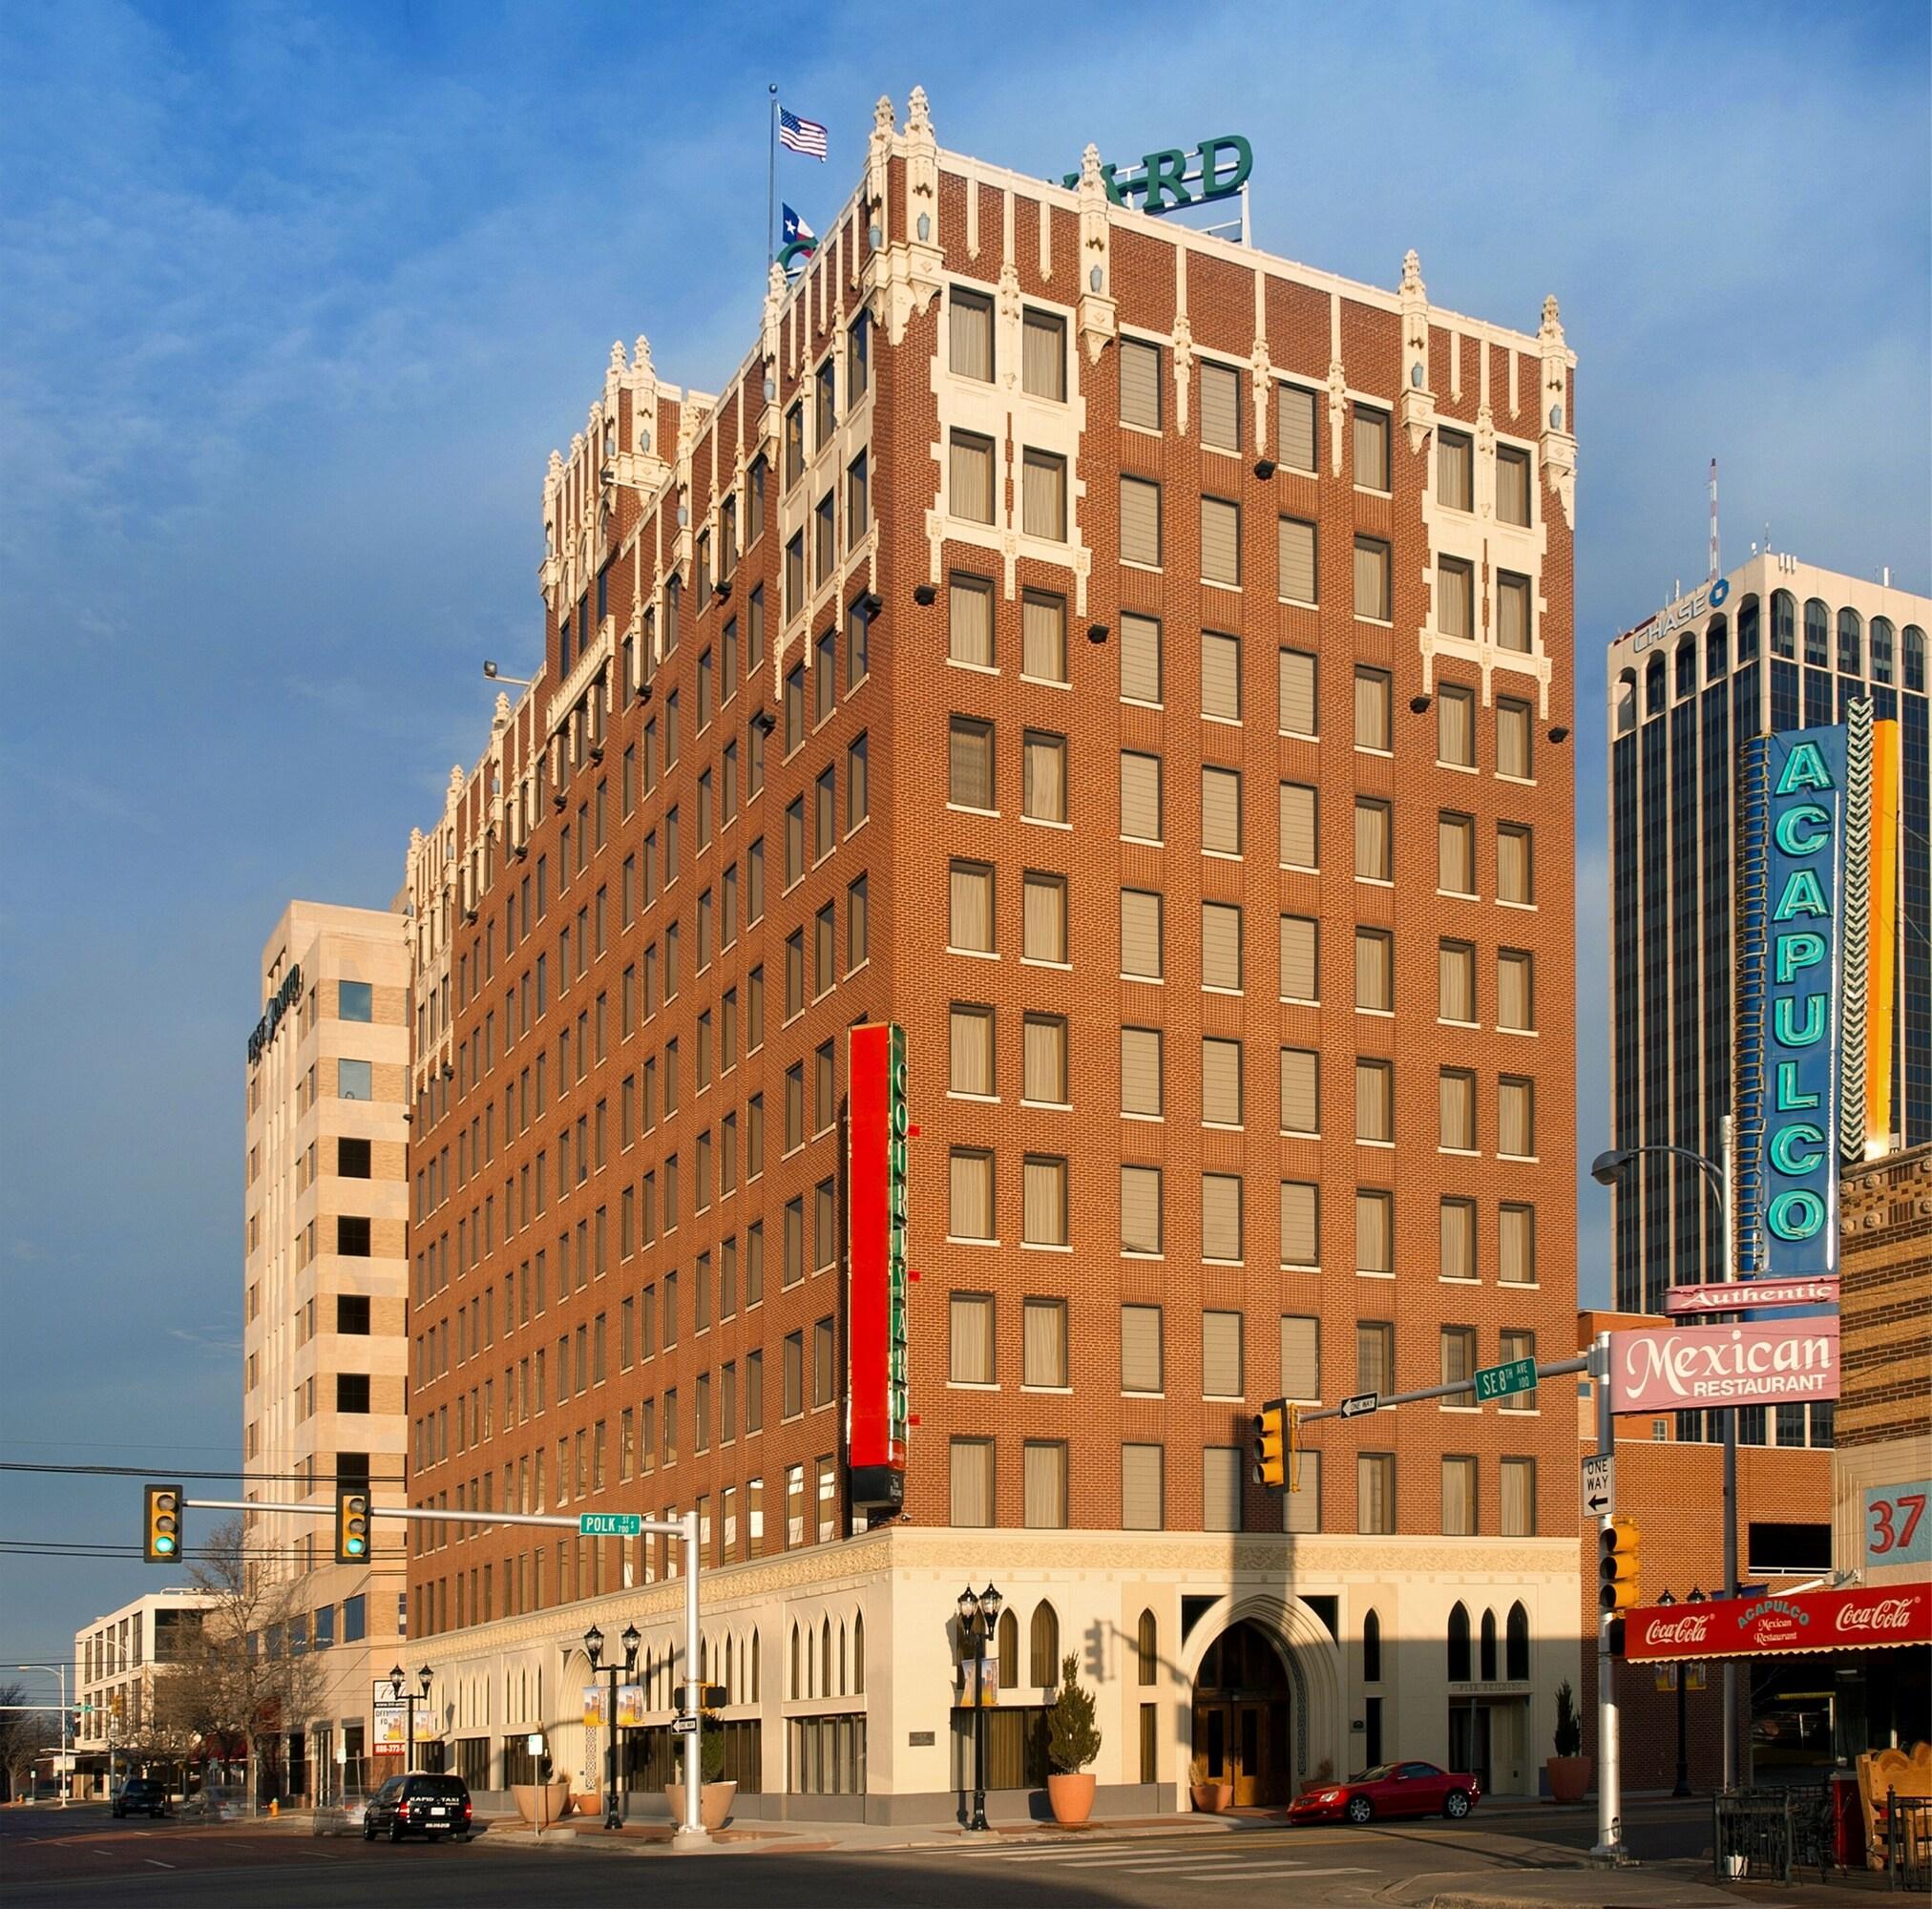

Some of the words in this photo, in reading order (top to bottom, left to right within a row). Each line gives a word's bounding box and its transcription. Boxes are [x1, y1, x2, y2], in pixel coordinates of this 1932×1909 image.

[1633, 593, 1707, 653] CHASE
[1768, 740, 1836, 1241] ACAPULCO
[1681, 1283, 1833, 1307] Authentic
[1626, 1330, 1833, 1398] Mexican
[1482, 1373, 1498, 1395] SE
[1516, 1362, 1528, 1375] AVE
[1693, 1374, 1827, 1397] RESTAURANT
[1350, 1401, 1361, 1412] ONE
[1362, 1398, 1375, 1408] WAY
[1587, 1458, 1607, 1475] ONE
[1586, 1475, 1608, 1491] WAY
[586, 1517, 616, 1532] POLK
[622, 1516, 630, 1524] ST
[1868, 1494, 1926, 1554] 37
[1737, 1600, 1810, 1628] ACAPULCO
[1757, 1618, 1793, 1631] Mexican
[1836, 1598, 1914, 1632] Coca-Cola
[1646, 1614, 1710, 1646] Coca-Cola
[1754, 1630, 1798, 1647] Restaurant
